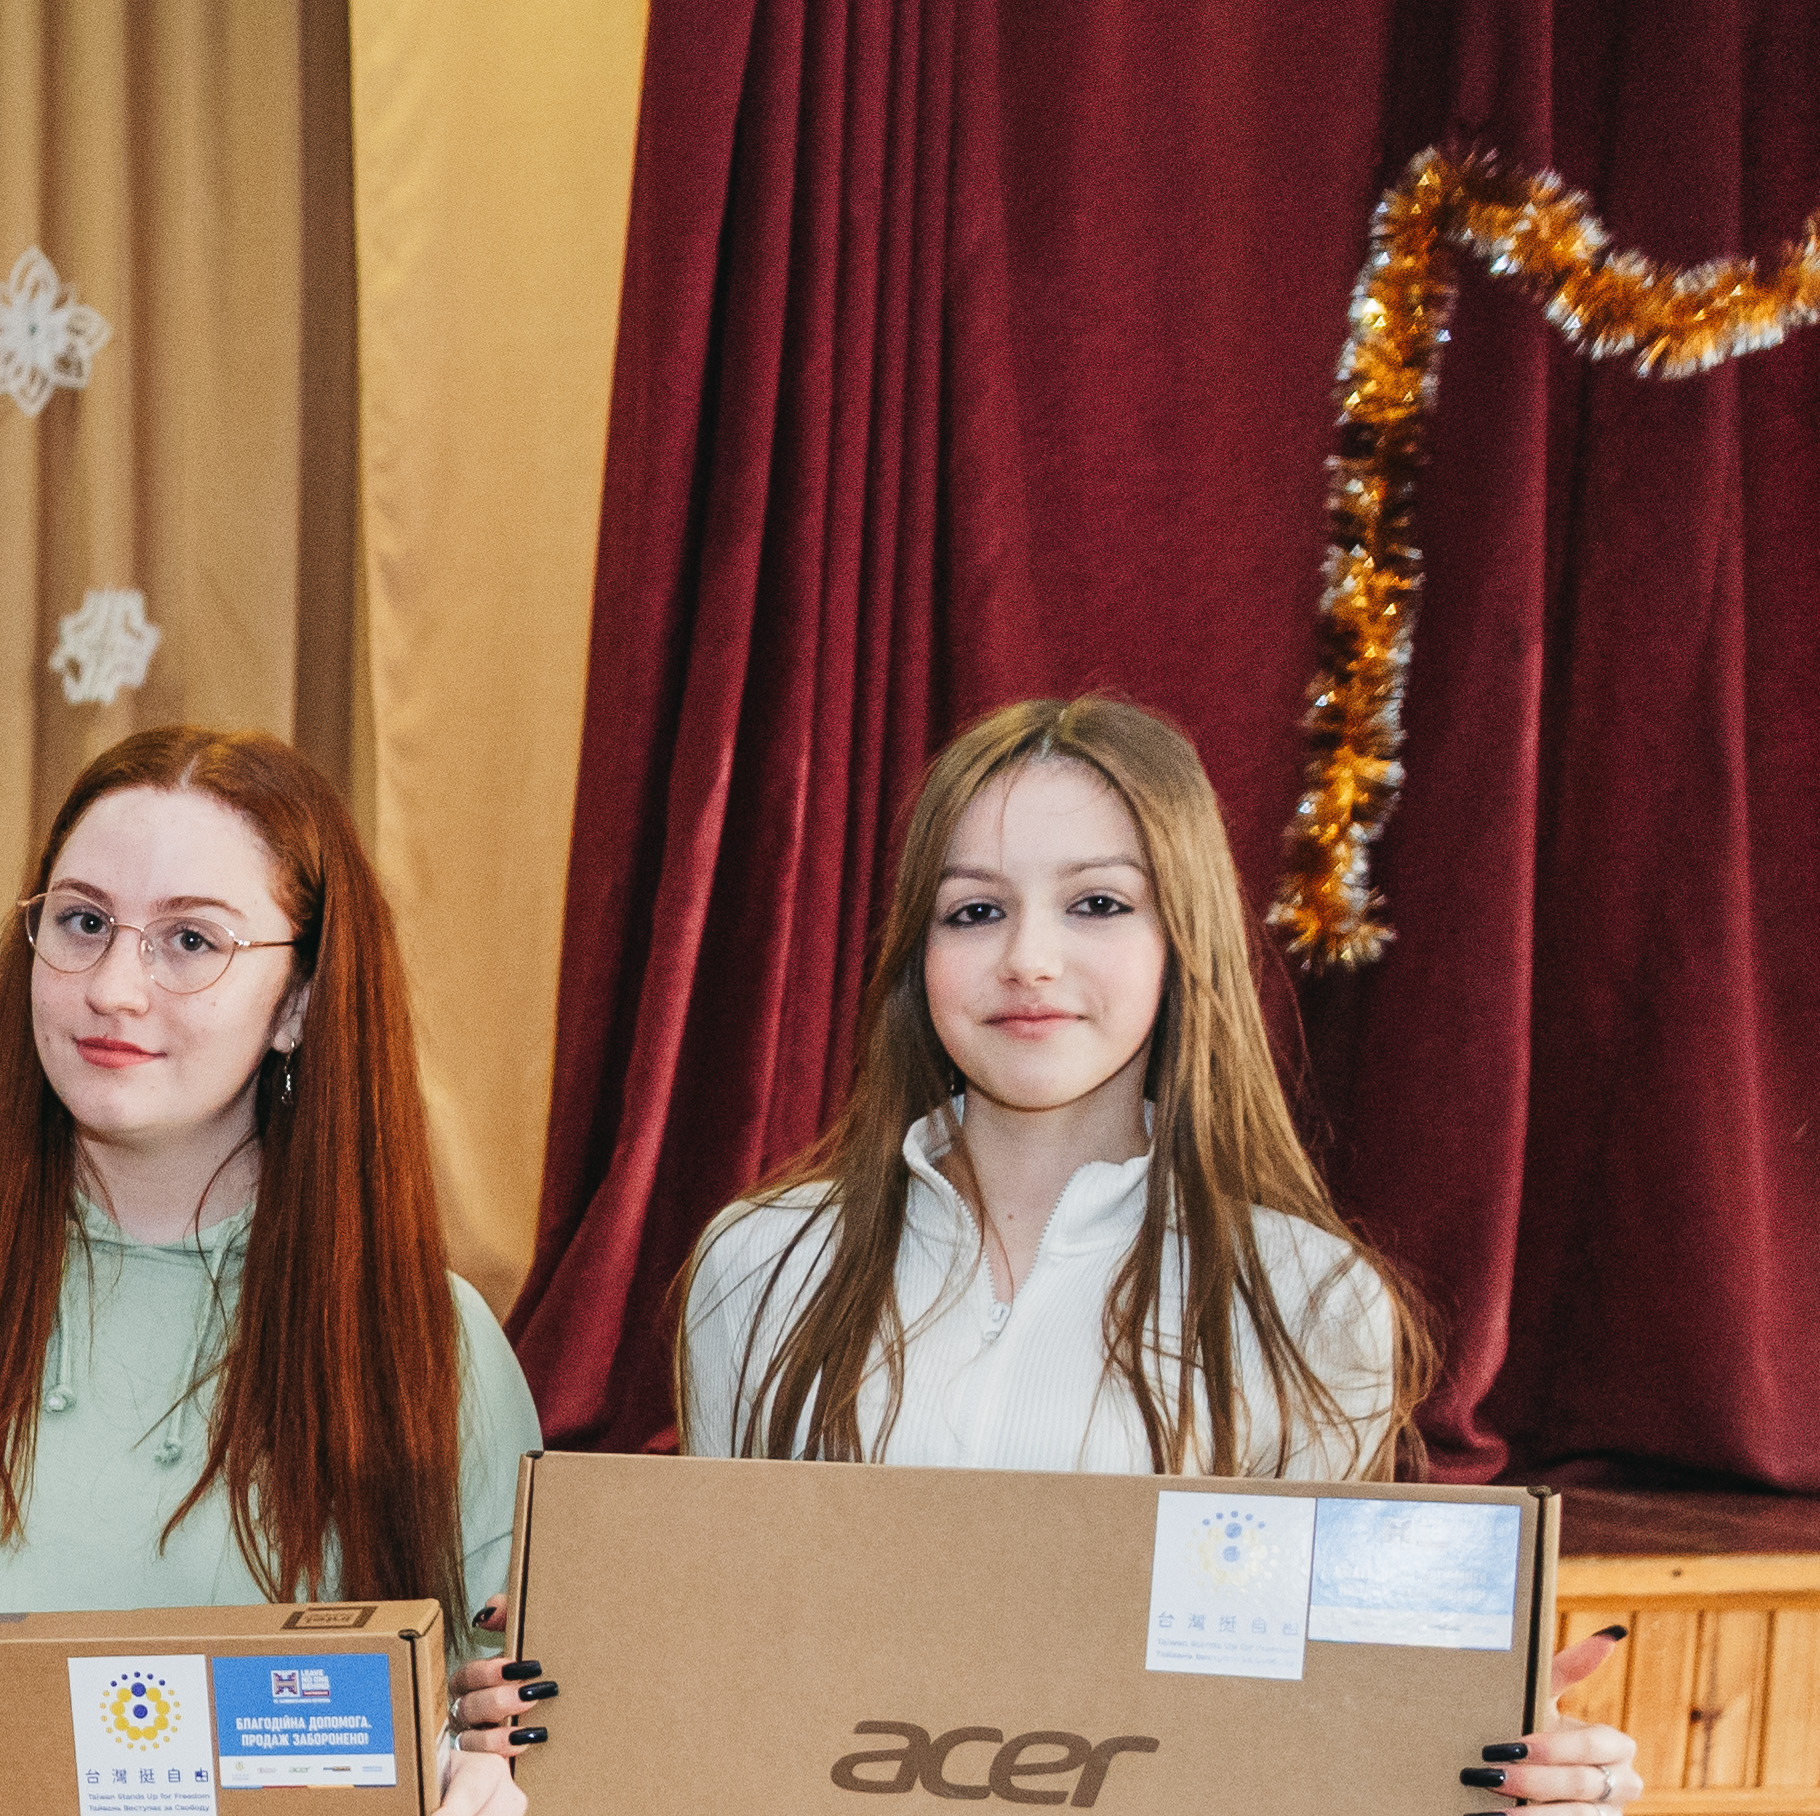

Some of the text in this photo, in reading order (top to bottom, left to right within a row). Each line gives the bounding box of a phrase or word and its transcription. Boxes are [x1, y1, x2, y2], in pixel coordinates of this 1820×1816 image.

[236, 1715, 372, 1732] БЛАГОДІЙНА ДОПОМОГА.
[241, 1732, 369, 1749] ПРОДАЖ ЗАБОРОНЕНО!
[830, 1720, 1160, 1809] acer
